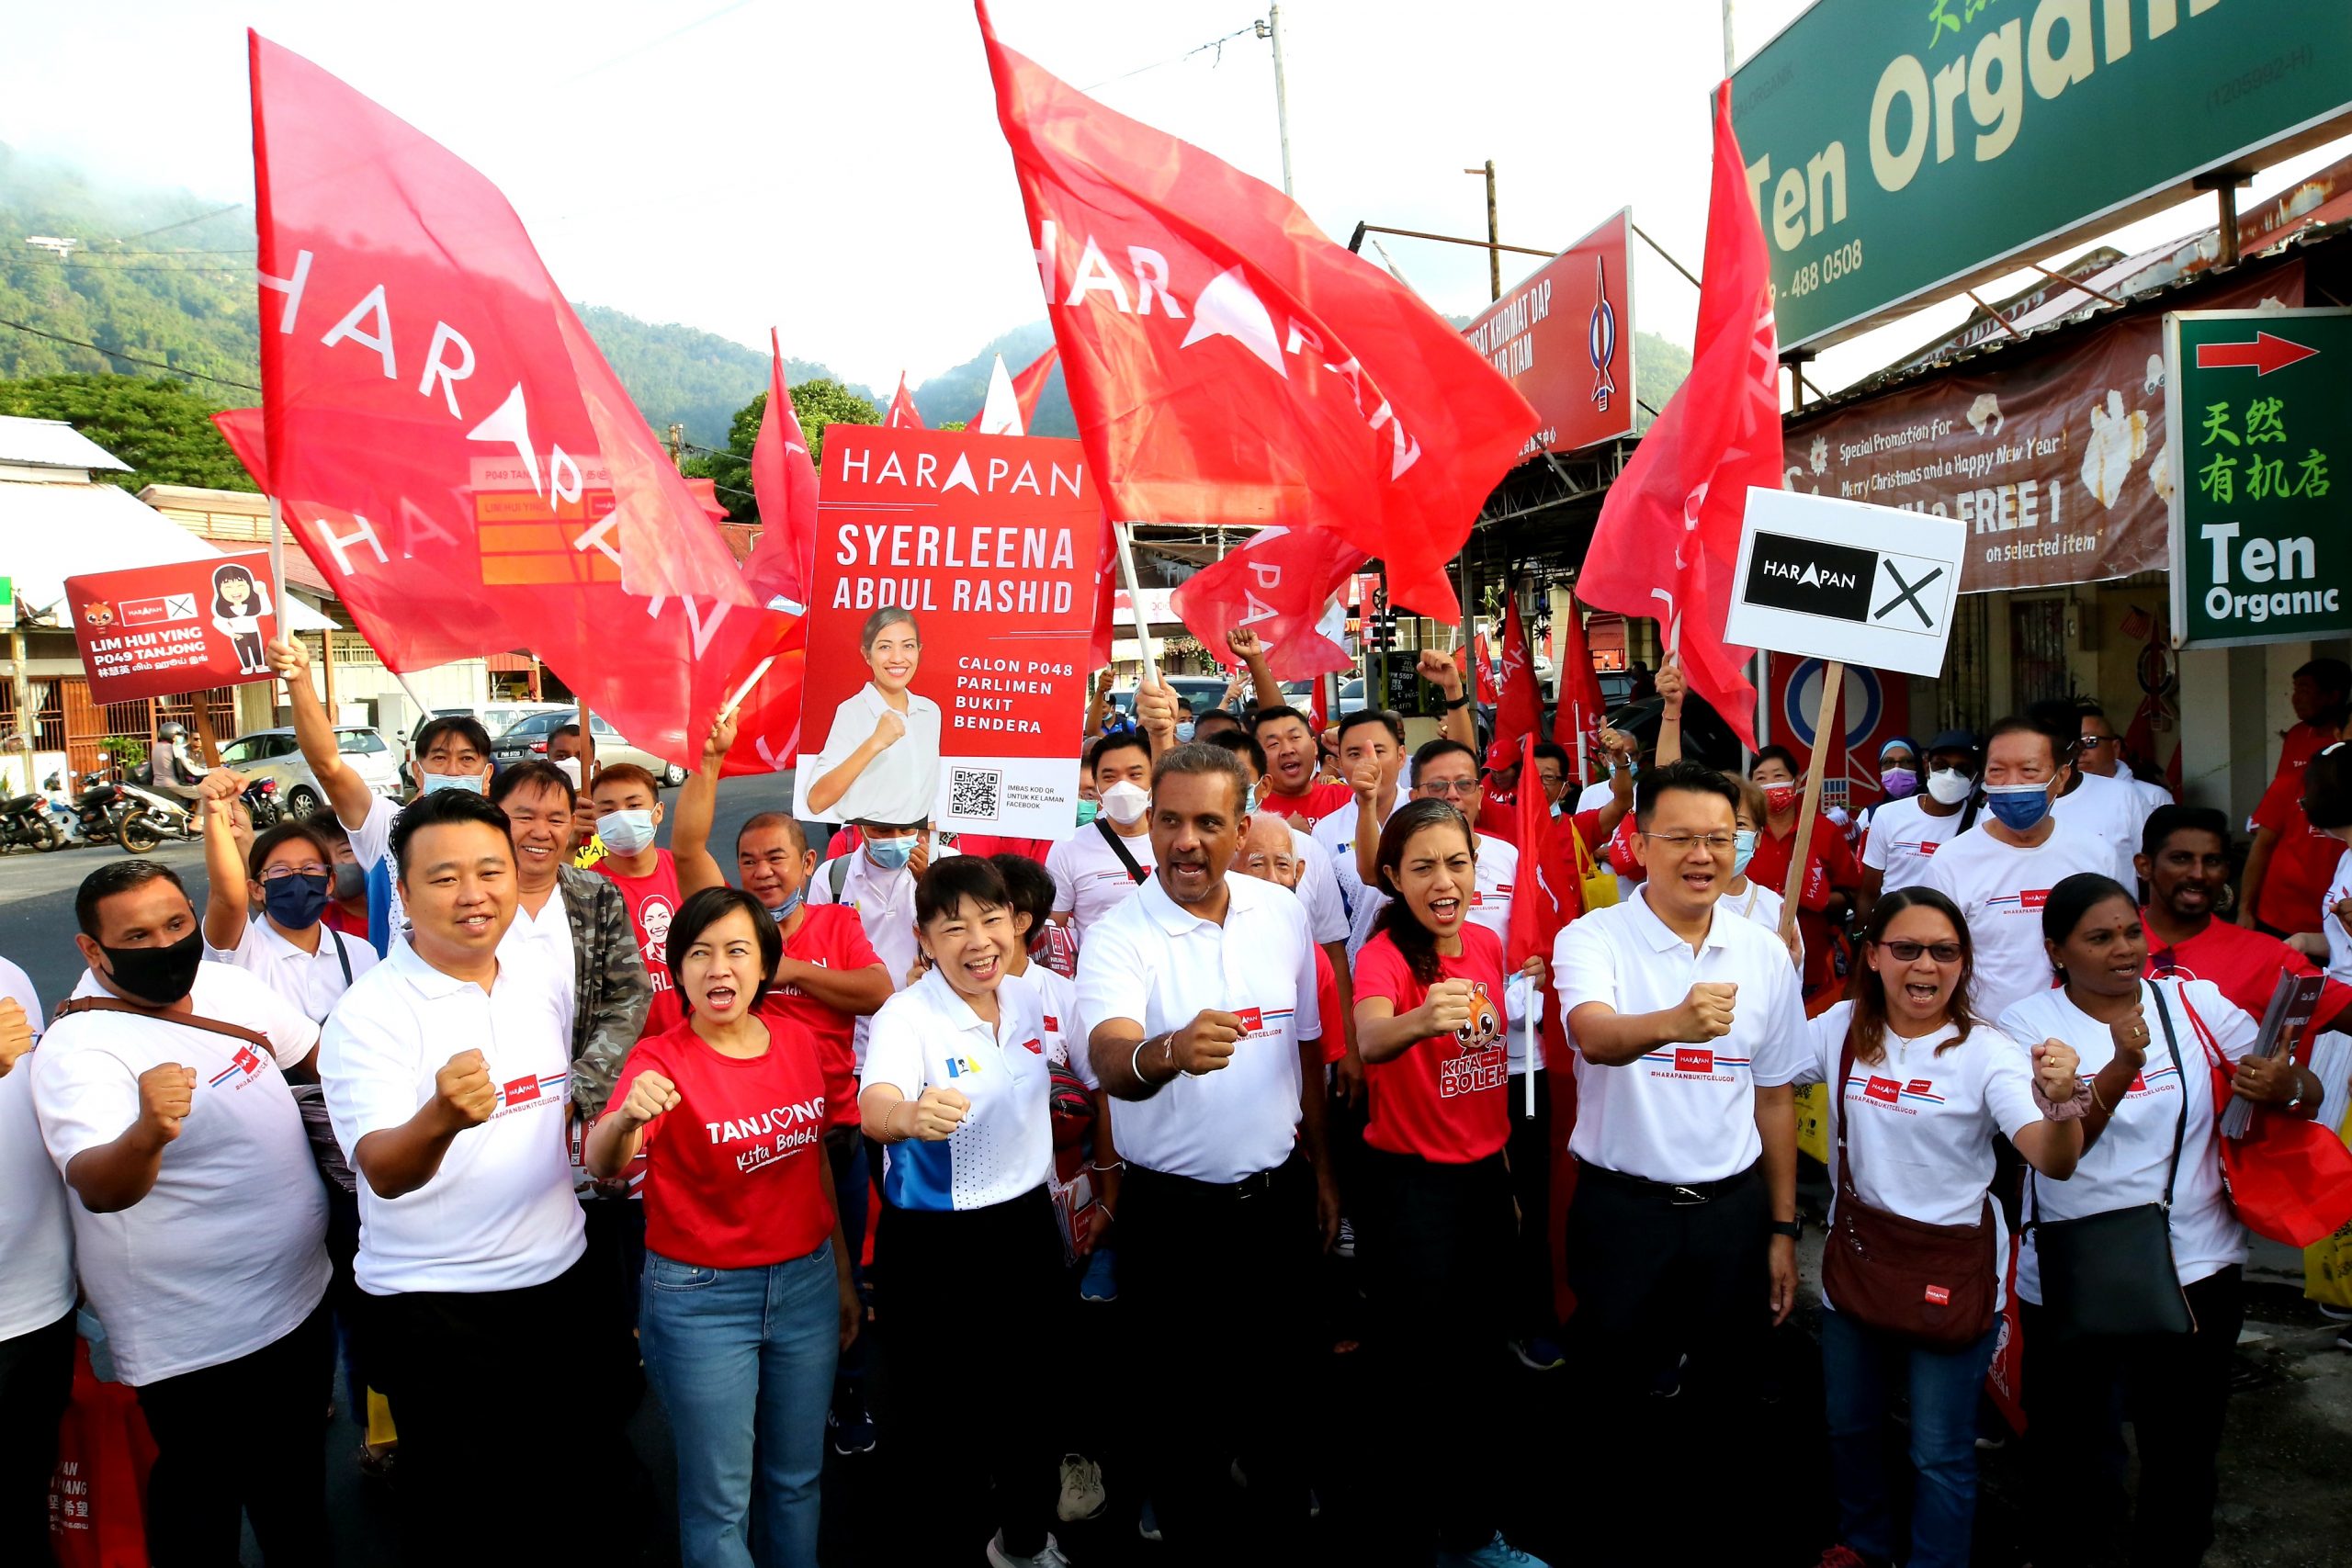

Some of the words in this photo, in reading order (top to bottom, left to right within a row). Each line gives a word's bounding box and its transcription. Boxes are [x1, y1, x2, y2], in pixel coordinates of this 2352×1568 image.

[1792, 261, 1819, 299] 488
[1823, 238, 1863, 284] 0508
[1490, 293, 1529, 351] KHIDMAT
[1532, 278, 1552, 324] DAP
[1510, 332, 1532, 378] ITAM
[2200, 396, 2287, 447] 天然
[1839, 436, 1873, 462] Special
[1874, 425, 1928, 450] Promotion
[1930, 418, 1953, 437] for
[842, 447, 1082, 499] HARAPAN
[1841, 479, 1870, 501] Merry
[1871, 468, 1922, 492] Christmas
[1924, 464, 1943, 480] and
[1945, 467, 1952, 477] a
[1954, 452, 1995, 479] Happy
[1996, 445, 2023, 465] New
[2026, 436, 2059, 459] Year
[2199, 448, 2331, 504] 有机店
[1956, 479, 2039, 535] FREE
[2049, 479, 2061, 525] 1
[836, 524, 1074, 569] SYERLEENA
[1986, 546, 2002, 562] on
[2004, 532, 2060, 561] selected
[2200, 522, 2316, 584] Ten
[1763, 559, 1856, 590] HARAPAN
[128, 606, 163, 616] HARAPAN
[832, 577, 938, 611] ABDUL
[952, 580, 1072, 614] RASHID
[2205, 586, 2339, 623] Organic
[90, 638, 122, 653] LIM
[125, 633, 157, 649] HUI
[159, 626, 203, 644] YING
[95, 651, 133, 666] P049
[135, 641, 206, 660] TANJONG
[97, 665, 130, 678] 林慧英
[958, 657, 1020, 672] CALON
[1028, 660, 1073, 677] P048
[956, 676, 1053, 695] PARLIMEN
[956, 695, 1013, 712] BUKIT
[954, 716, 1042, 734] BENDERA
[1006, 801, 1041, 809] FACEBOOK
[1442, 1055, 1481, 1077] KITA
[1680, 1055, 1709, 1064] HARAPAN
[508, 1083, 536, 1096] HARAPAN
[1441, 1063, 1509, 1098] BOLEH
[1651, 1071, 1735, 1082] #HARAPANBUKITGELUGOR
[489, 1095, 560, 1121] HARAPANBUKITGELUGOR
[736, 1144, 770, 1171] Kita
[776, 1125, 819, 1153] Boleh!
